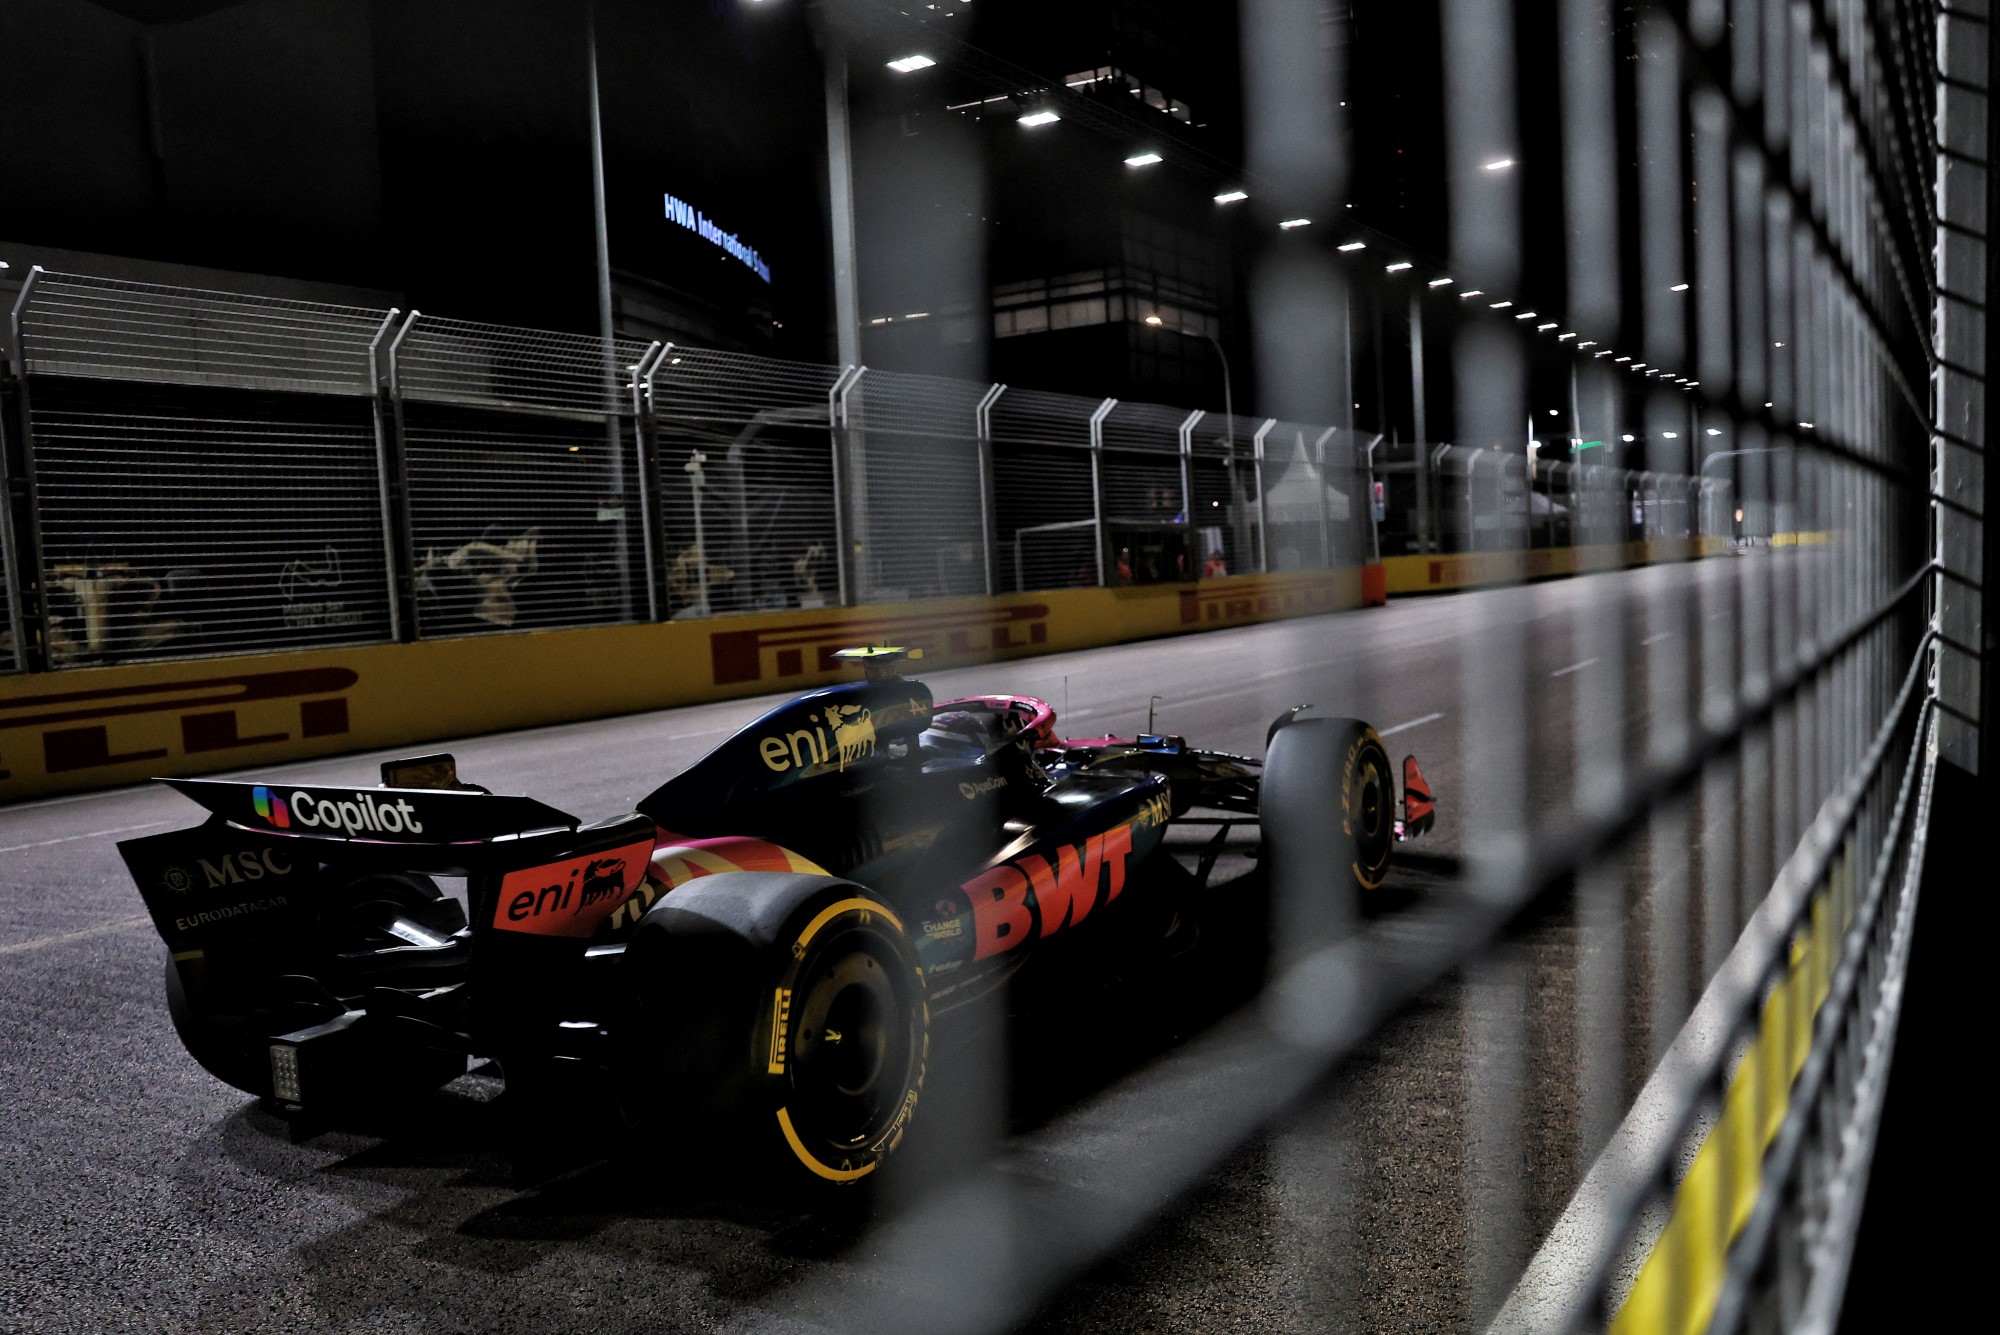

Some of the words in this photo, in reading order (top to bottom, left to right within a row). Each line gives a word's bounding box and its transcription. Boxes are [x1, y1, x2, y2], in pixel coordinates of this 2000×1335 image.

[664, 192, 697, 232] HWA
[759, 712, 830, 773] eni
[290, 790, 424, 837] Copilot
[196, 847, 293, 889] MSC
[175, 895, 289, 931] EURODATACAR
[508, 868, 580, 922] eni
[960, 823, 1133, 962] BWT
[923, 918, 961, 934] CHANGE
[767, 986, 792, 1075] PIRELLI
